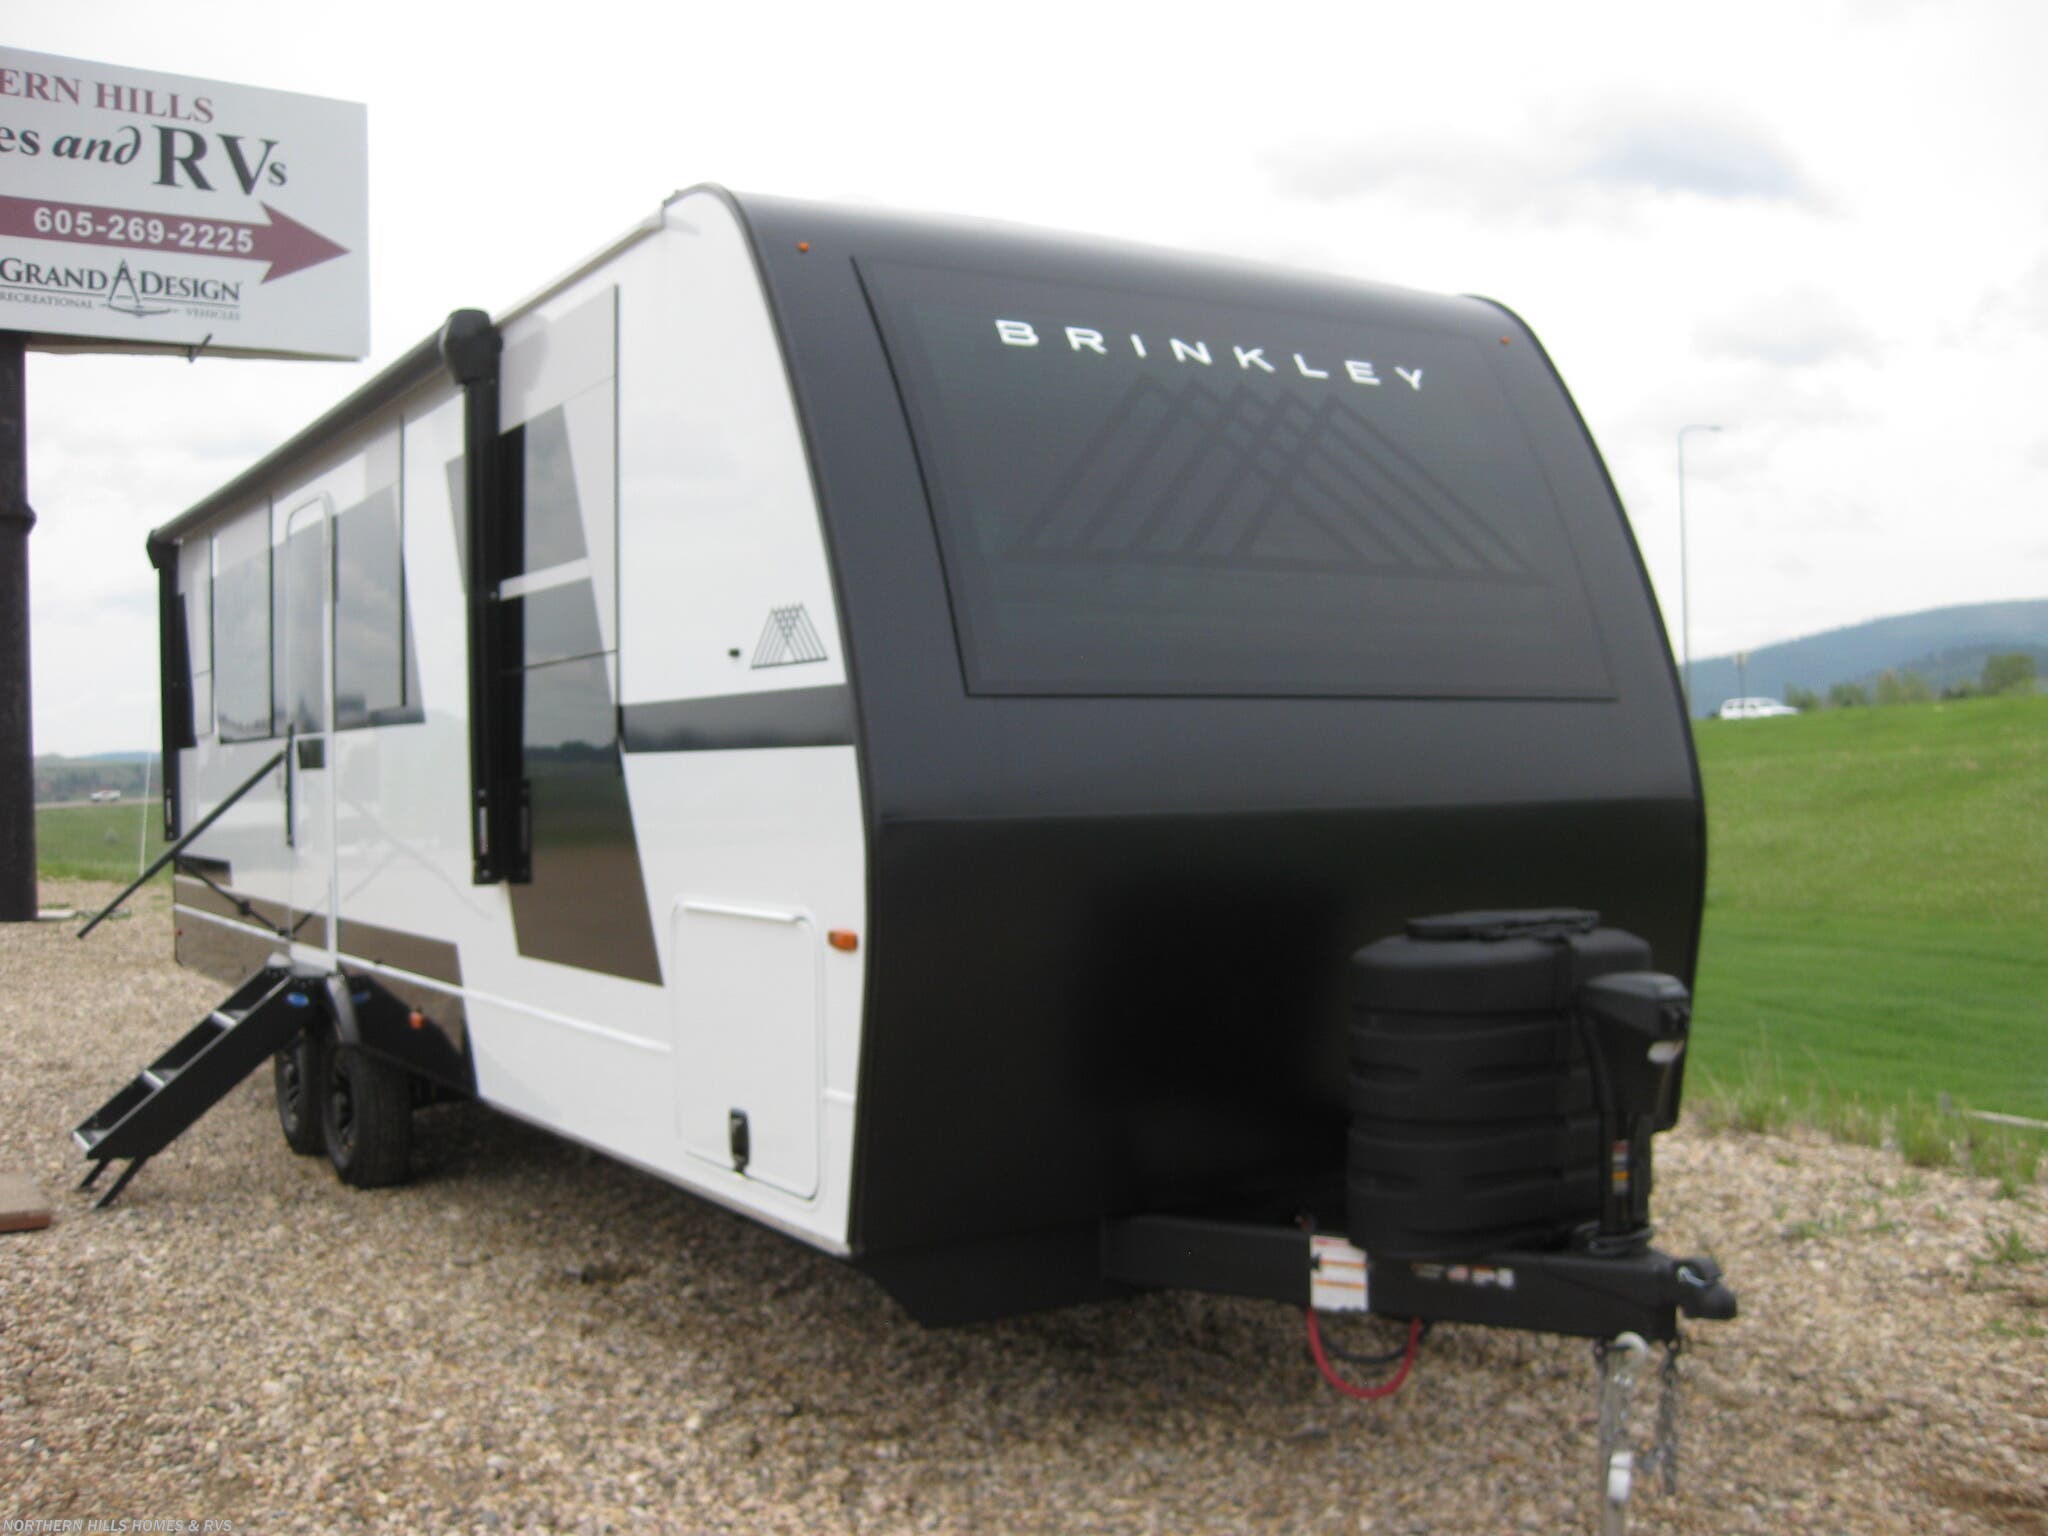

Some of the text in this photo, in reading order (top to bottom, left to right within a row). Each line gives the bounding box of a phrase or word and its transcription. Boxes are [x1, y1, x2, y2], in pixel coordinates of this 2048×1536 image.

[94, 82, 214, 124] HILLS
[0, 125, 287, 196] es and RVs
[33, 208, 254, 253] 605-269-2225
[139, 270, 240, 301] DESIGN
[995, 319, 1423, 391] BRINKLEY
